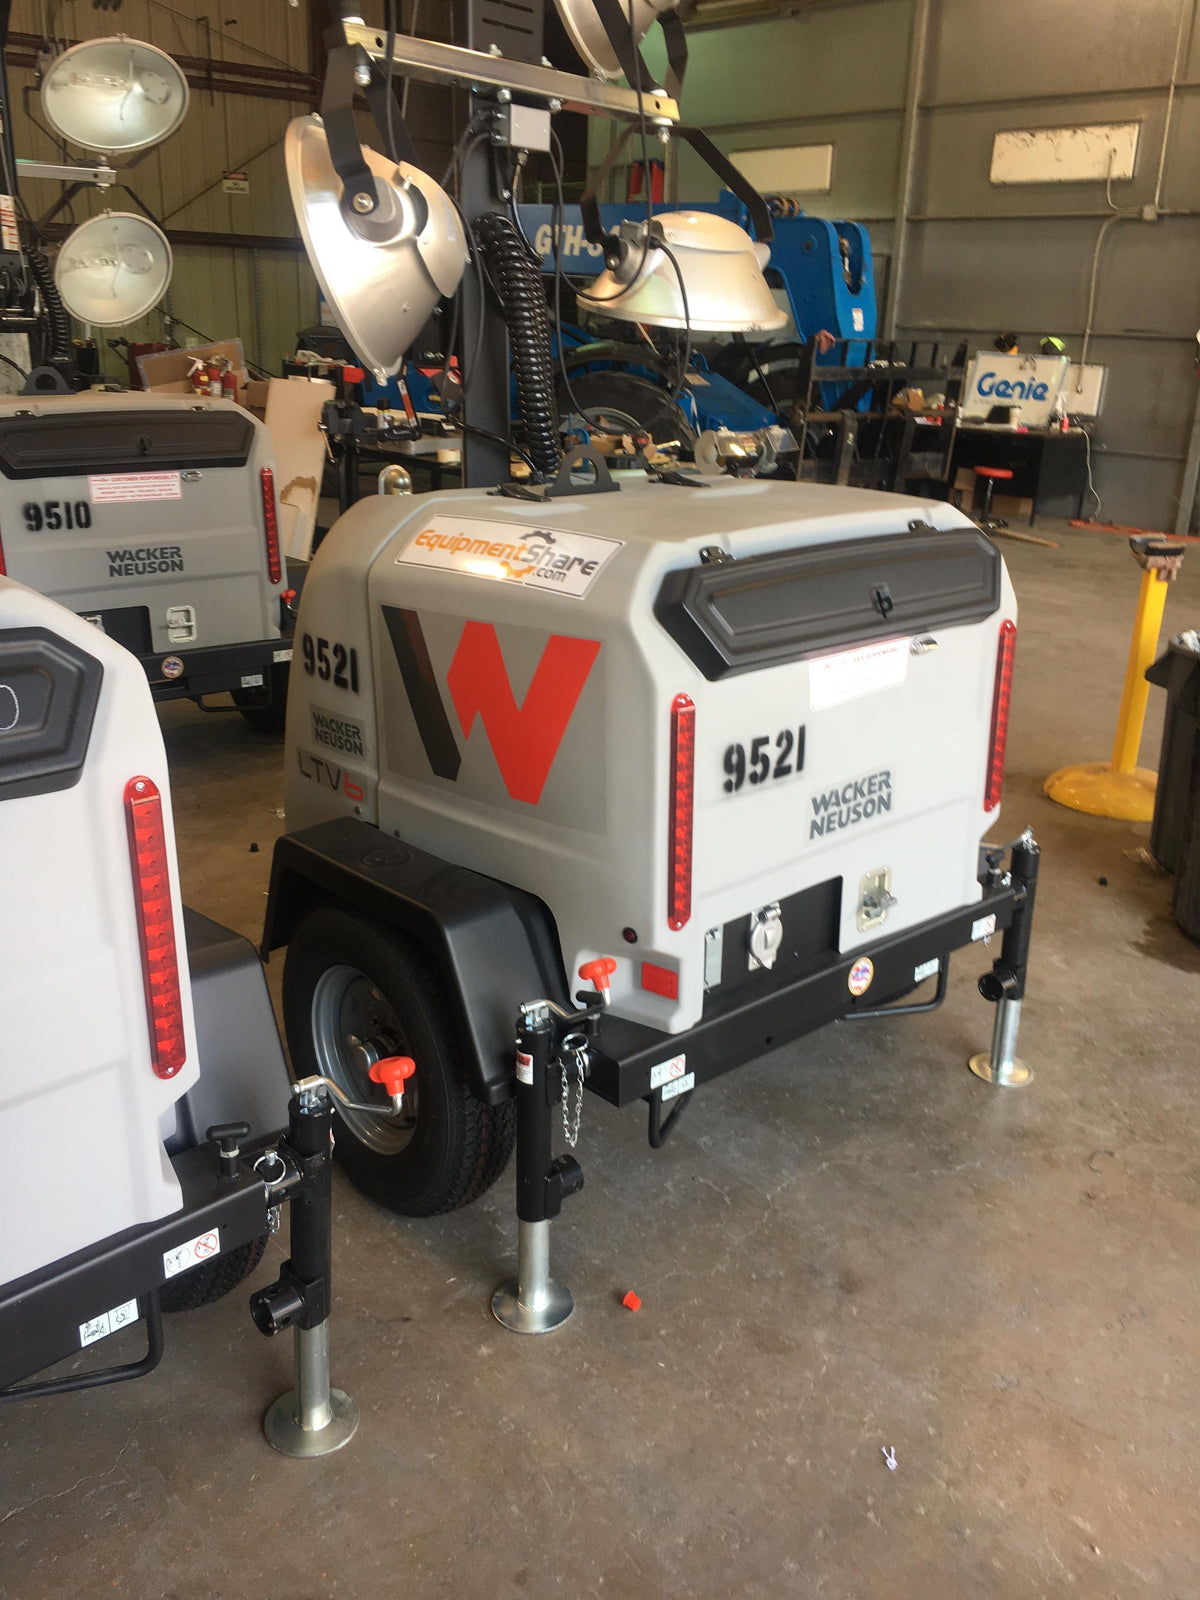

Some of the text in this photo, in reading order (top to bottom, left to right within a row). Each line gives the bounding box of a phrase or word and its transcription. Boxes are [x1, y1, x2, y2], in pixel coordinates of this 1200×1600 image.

[977, 371, 1049, 401] Genie
[23, 500, 92, 531] 9510
[106, 546, 183, 564] WACKER
[109, 559, 184, 577] NEUSON
[415, 529, 599, 576] EquipmentShare
[302, 633, 359, 693] 9521
[312, 712, 362, 741] WACKER
[314, 729, 364, 756] NEUSON
[298, 752, 364, 801] LTV6
[723, 724, 806, 793] 9521
[811, 770, 892, 815] WACKER
[809, 792, 892, 839] NEUSON
